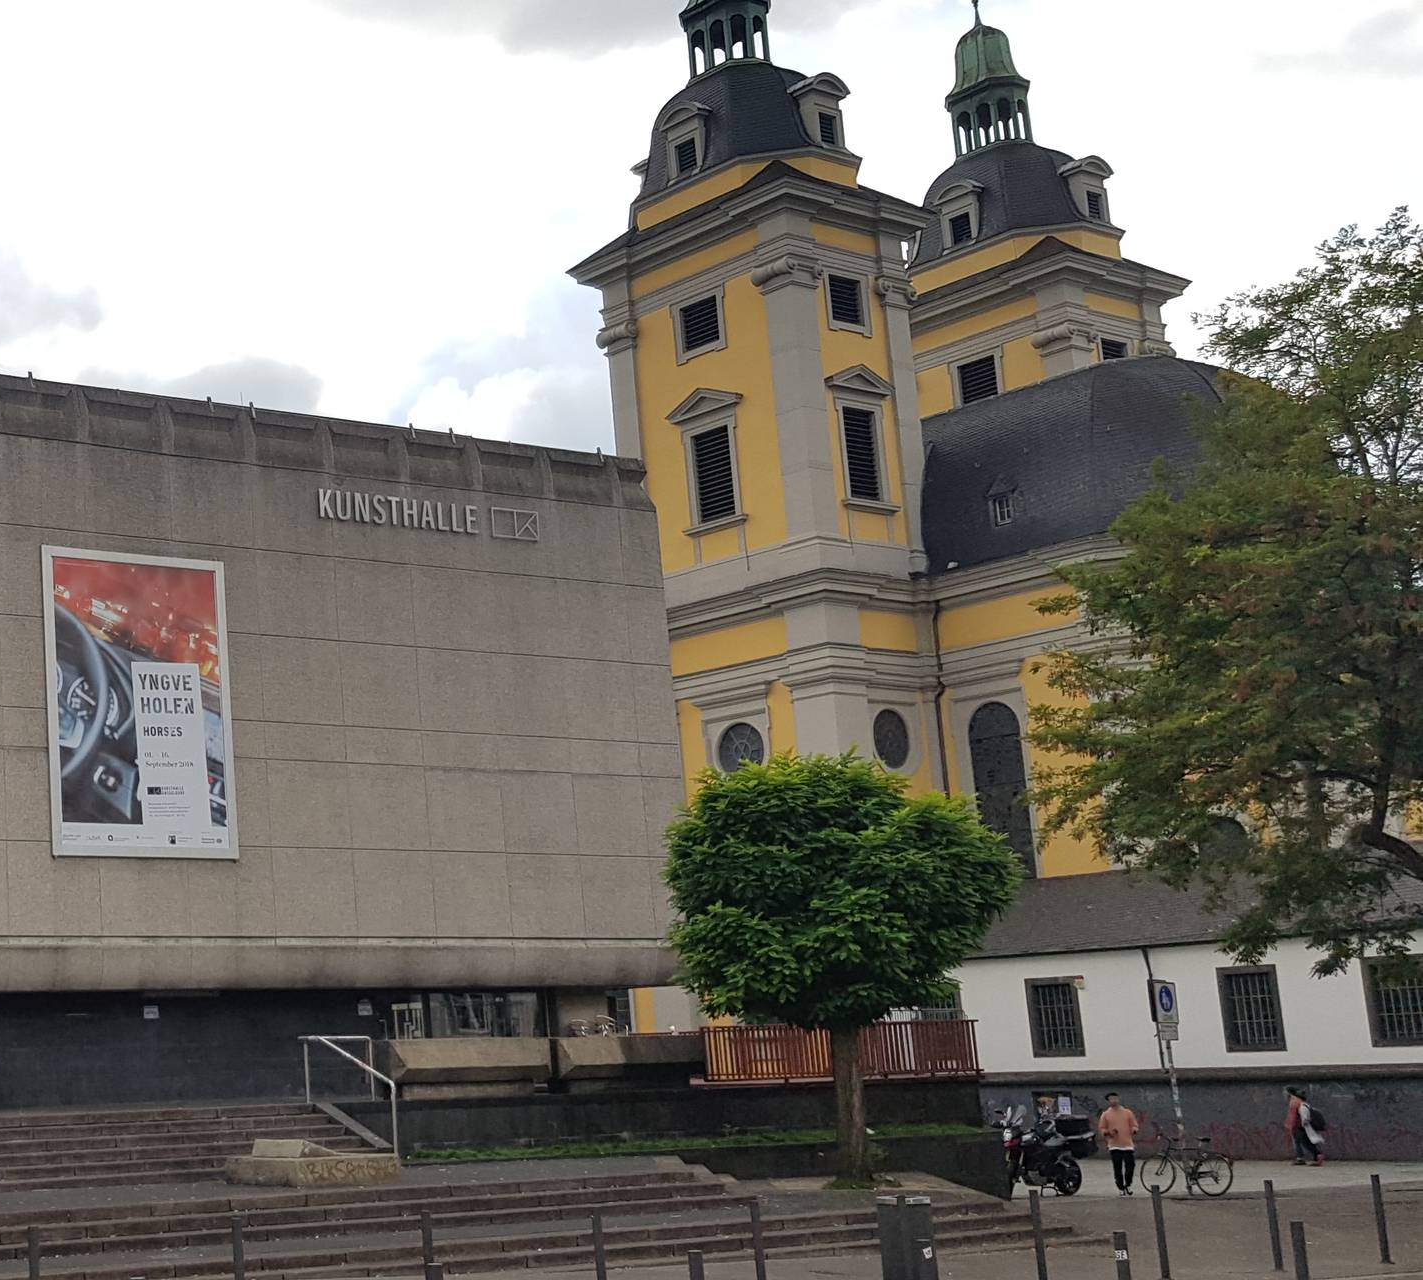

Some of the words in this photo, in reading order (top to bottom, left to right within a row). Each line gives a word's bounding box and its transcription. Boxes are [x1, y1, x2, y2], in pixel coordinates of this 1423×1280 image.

[318, 488, 479, 535] KUNSTHALLE
[138, 673, 192, 692] YNGVE
[140, 697, 195, 715] HOLEN
[143, 726, 183, 737] HORSES
